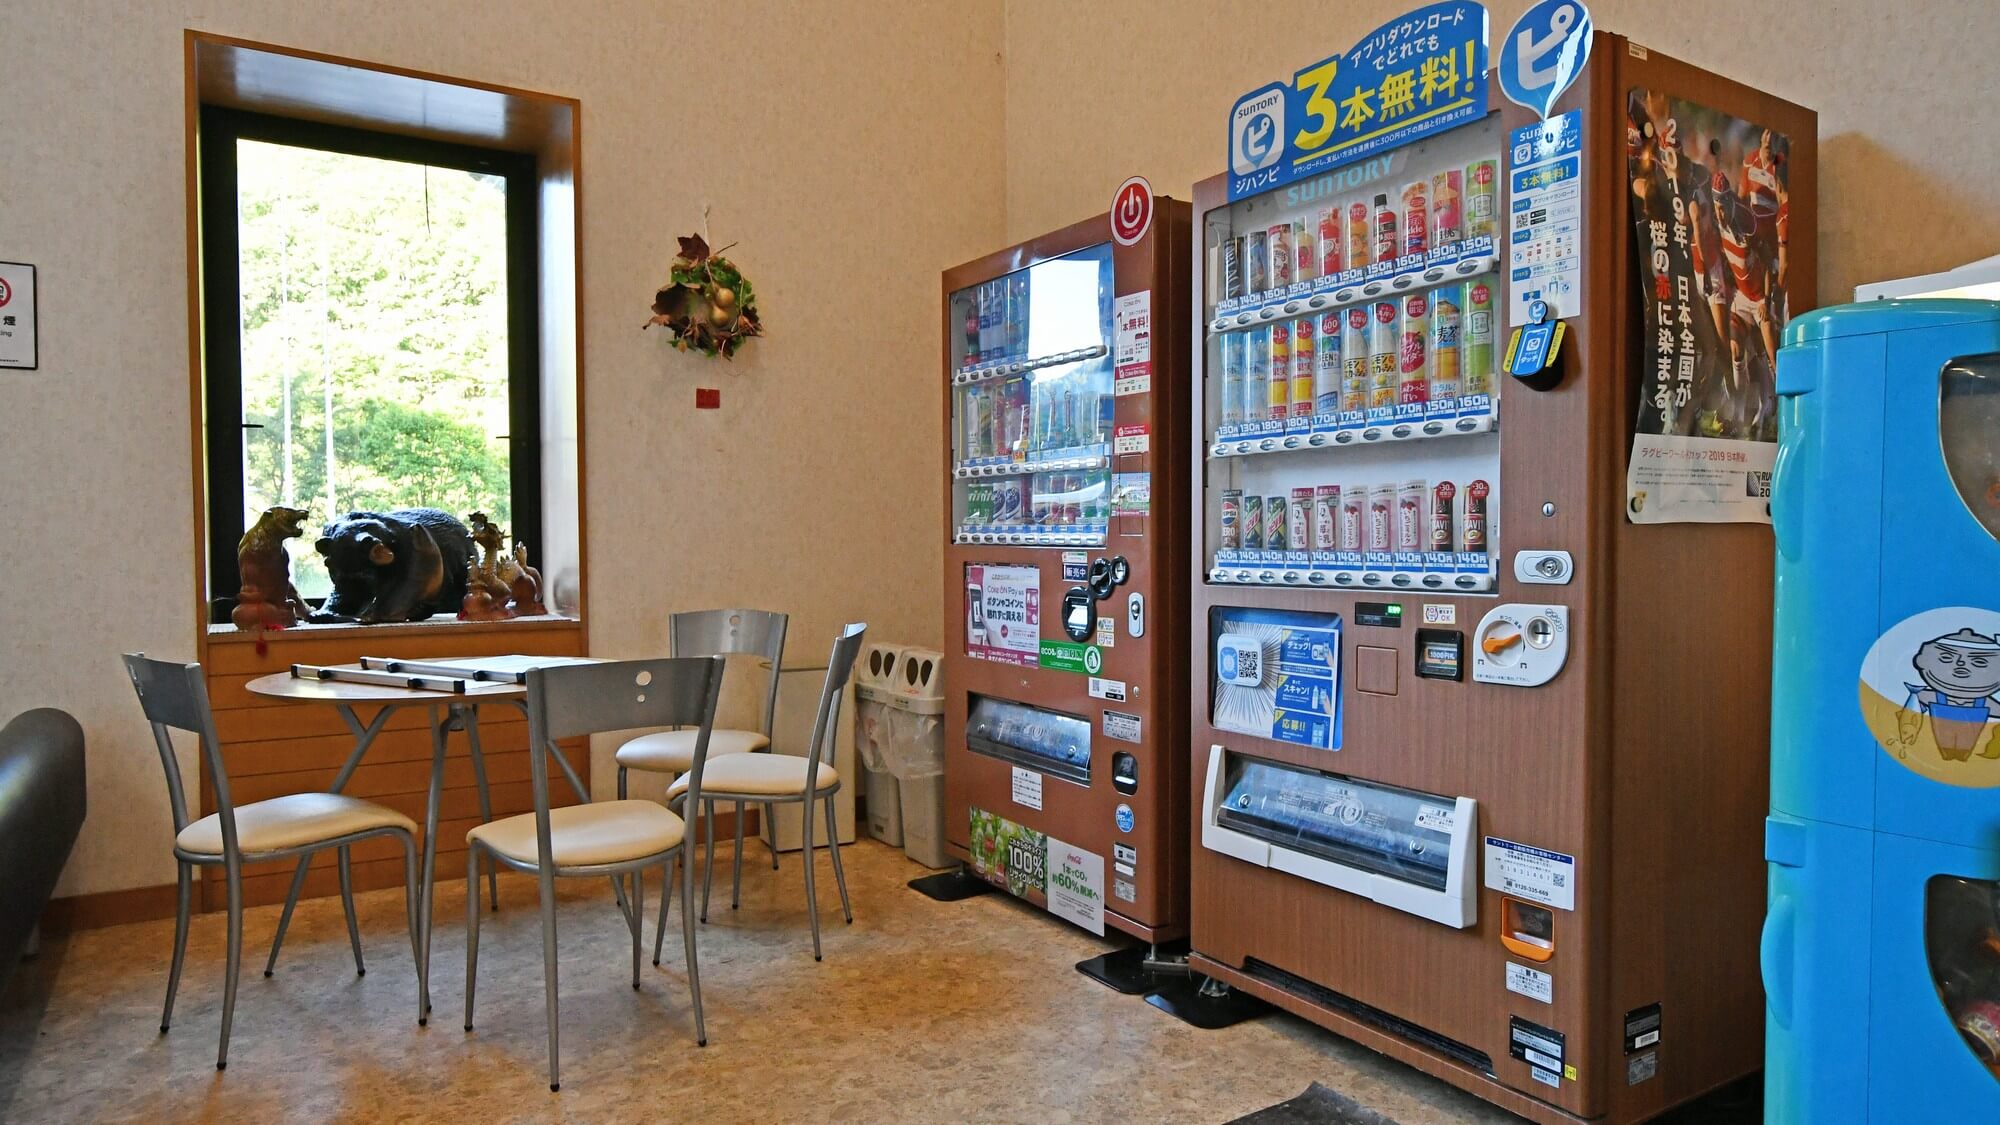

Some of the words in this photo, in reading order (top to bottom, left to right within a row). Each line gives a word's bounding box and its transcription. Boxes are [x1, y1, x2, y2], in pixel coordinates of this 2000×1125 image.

[1350, 7, 1466, 66] アプリダウンロード
[1372, 34, 1440, 71] でどれでも
[1517, 4, 1577, 91] ピ
[1238, 94, 1279, 119] SUNTORY
[1247, 121, 1269, 155] ピ
[1235, 167, 1279, 194] ジハンピ
[1287, 154, 1394, 208] SUNTORY
[1461, 236, 1491, 249] 150円
[1427, 245, 1456, 259] 190円
[1395, 253, 1422, 266] 160円
[1367, 261, 1392, 274] 150円
[1339, 268, 1362, 281] 150円
[1288, 281, 1311, 291] 150円
[1314, 275, 1337, 287] 150円
[1264, 288, 1285, 298] 160円
[1218, 300, 1238, 309] 140円
[1240, 295, 1260, 305] 140円
[1649, 220, 1675, 421] 桜の赤に染まる。
[1437, 325, 1460, 343] 麦茶
[1675, 275, 1695, 408] 日本全国が
[1426, 399, 1454, 411] 150円
[1459, 395, 1488, 406] 160円
[1368, 407, 1392, 417] 170円
[1396, 403, 1421, 414] 170円
[1313, 415, 1335, 424] 170円
[1340, 411, 1363, 420] 170円
[1240, 424, 1260, 432] 130円
[1261, 421, 1282, 429] 180円
[1286, 418, 1308, 427] 180円
[1219, 426, 1237, 434] 130円
[1709, 450, 1726, 461] 2019
[1218, 551, 1237, 560] 140円
[1240, 551, 1259, 560] 140円
[1261, 552, 1282, 560] 140円
[1286, 552, 1308, 560] 140円
[1312, 552, 1335, 560] 140円
[1337, 552, 1360, 561] 140円
[1366, 553, 1390, 562] 140円
[1395, 553, 1420, 562] 140円
[1424, 553, 1452, 563] 140円
[1456, 553, 1486, 563] 140円
[1066, 567, 1086, 578] 販売中
[987, 598, 1024, 608] ボタンやコインに
[987, 609, 1024, 622] 触れずに買える!
[1287, 641, 1311, 650] チェック!
[1284, 684, 1310, 695] スキャン!
[1008, 845, 1044, 879] 100%
